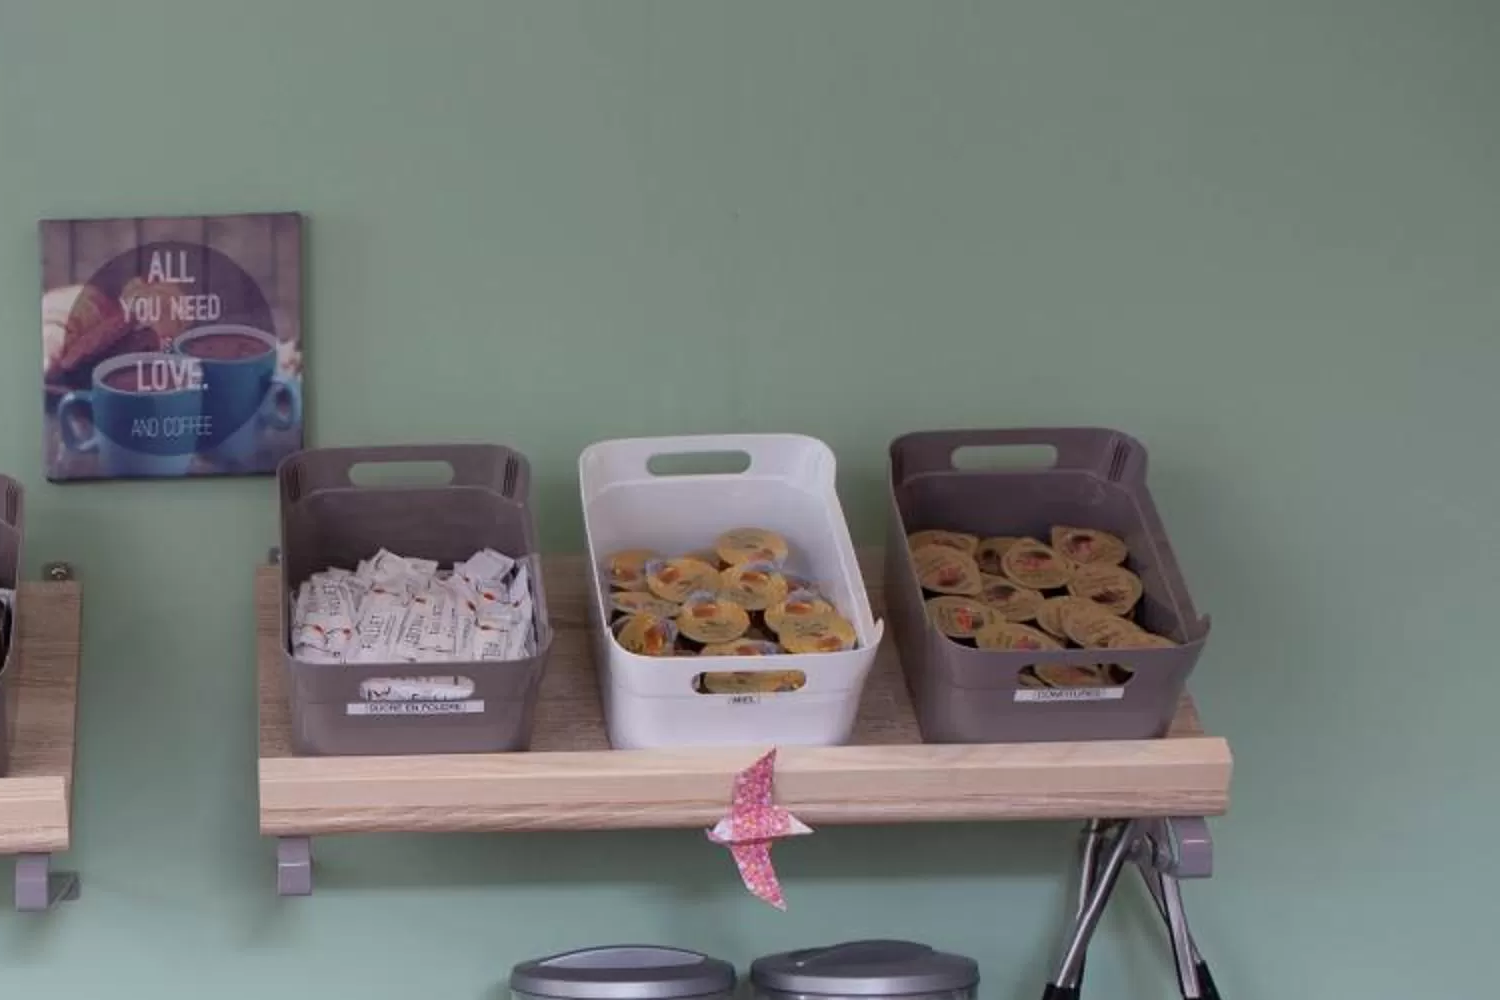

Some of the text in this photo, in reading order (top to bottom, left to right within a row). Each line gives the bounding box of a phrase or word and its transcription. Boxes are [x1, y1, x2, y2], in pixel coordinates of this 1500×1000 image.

[148, 251, 195, 283] ALL
[119, 295, 221, 322] YOU NEED
[131, 415, 213, 437] AND COFFEE
